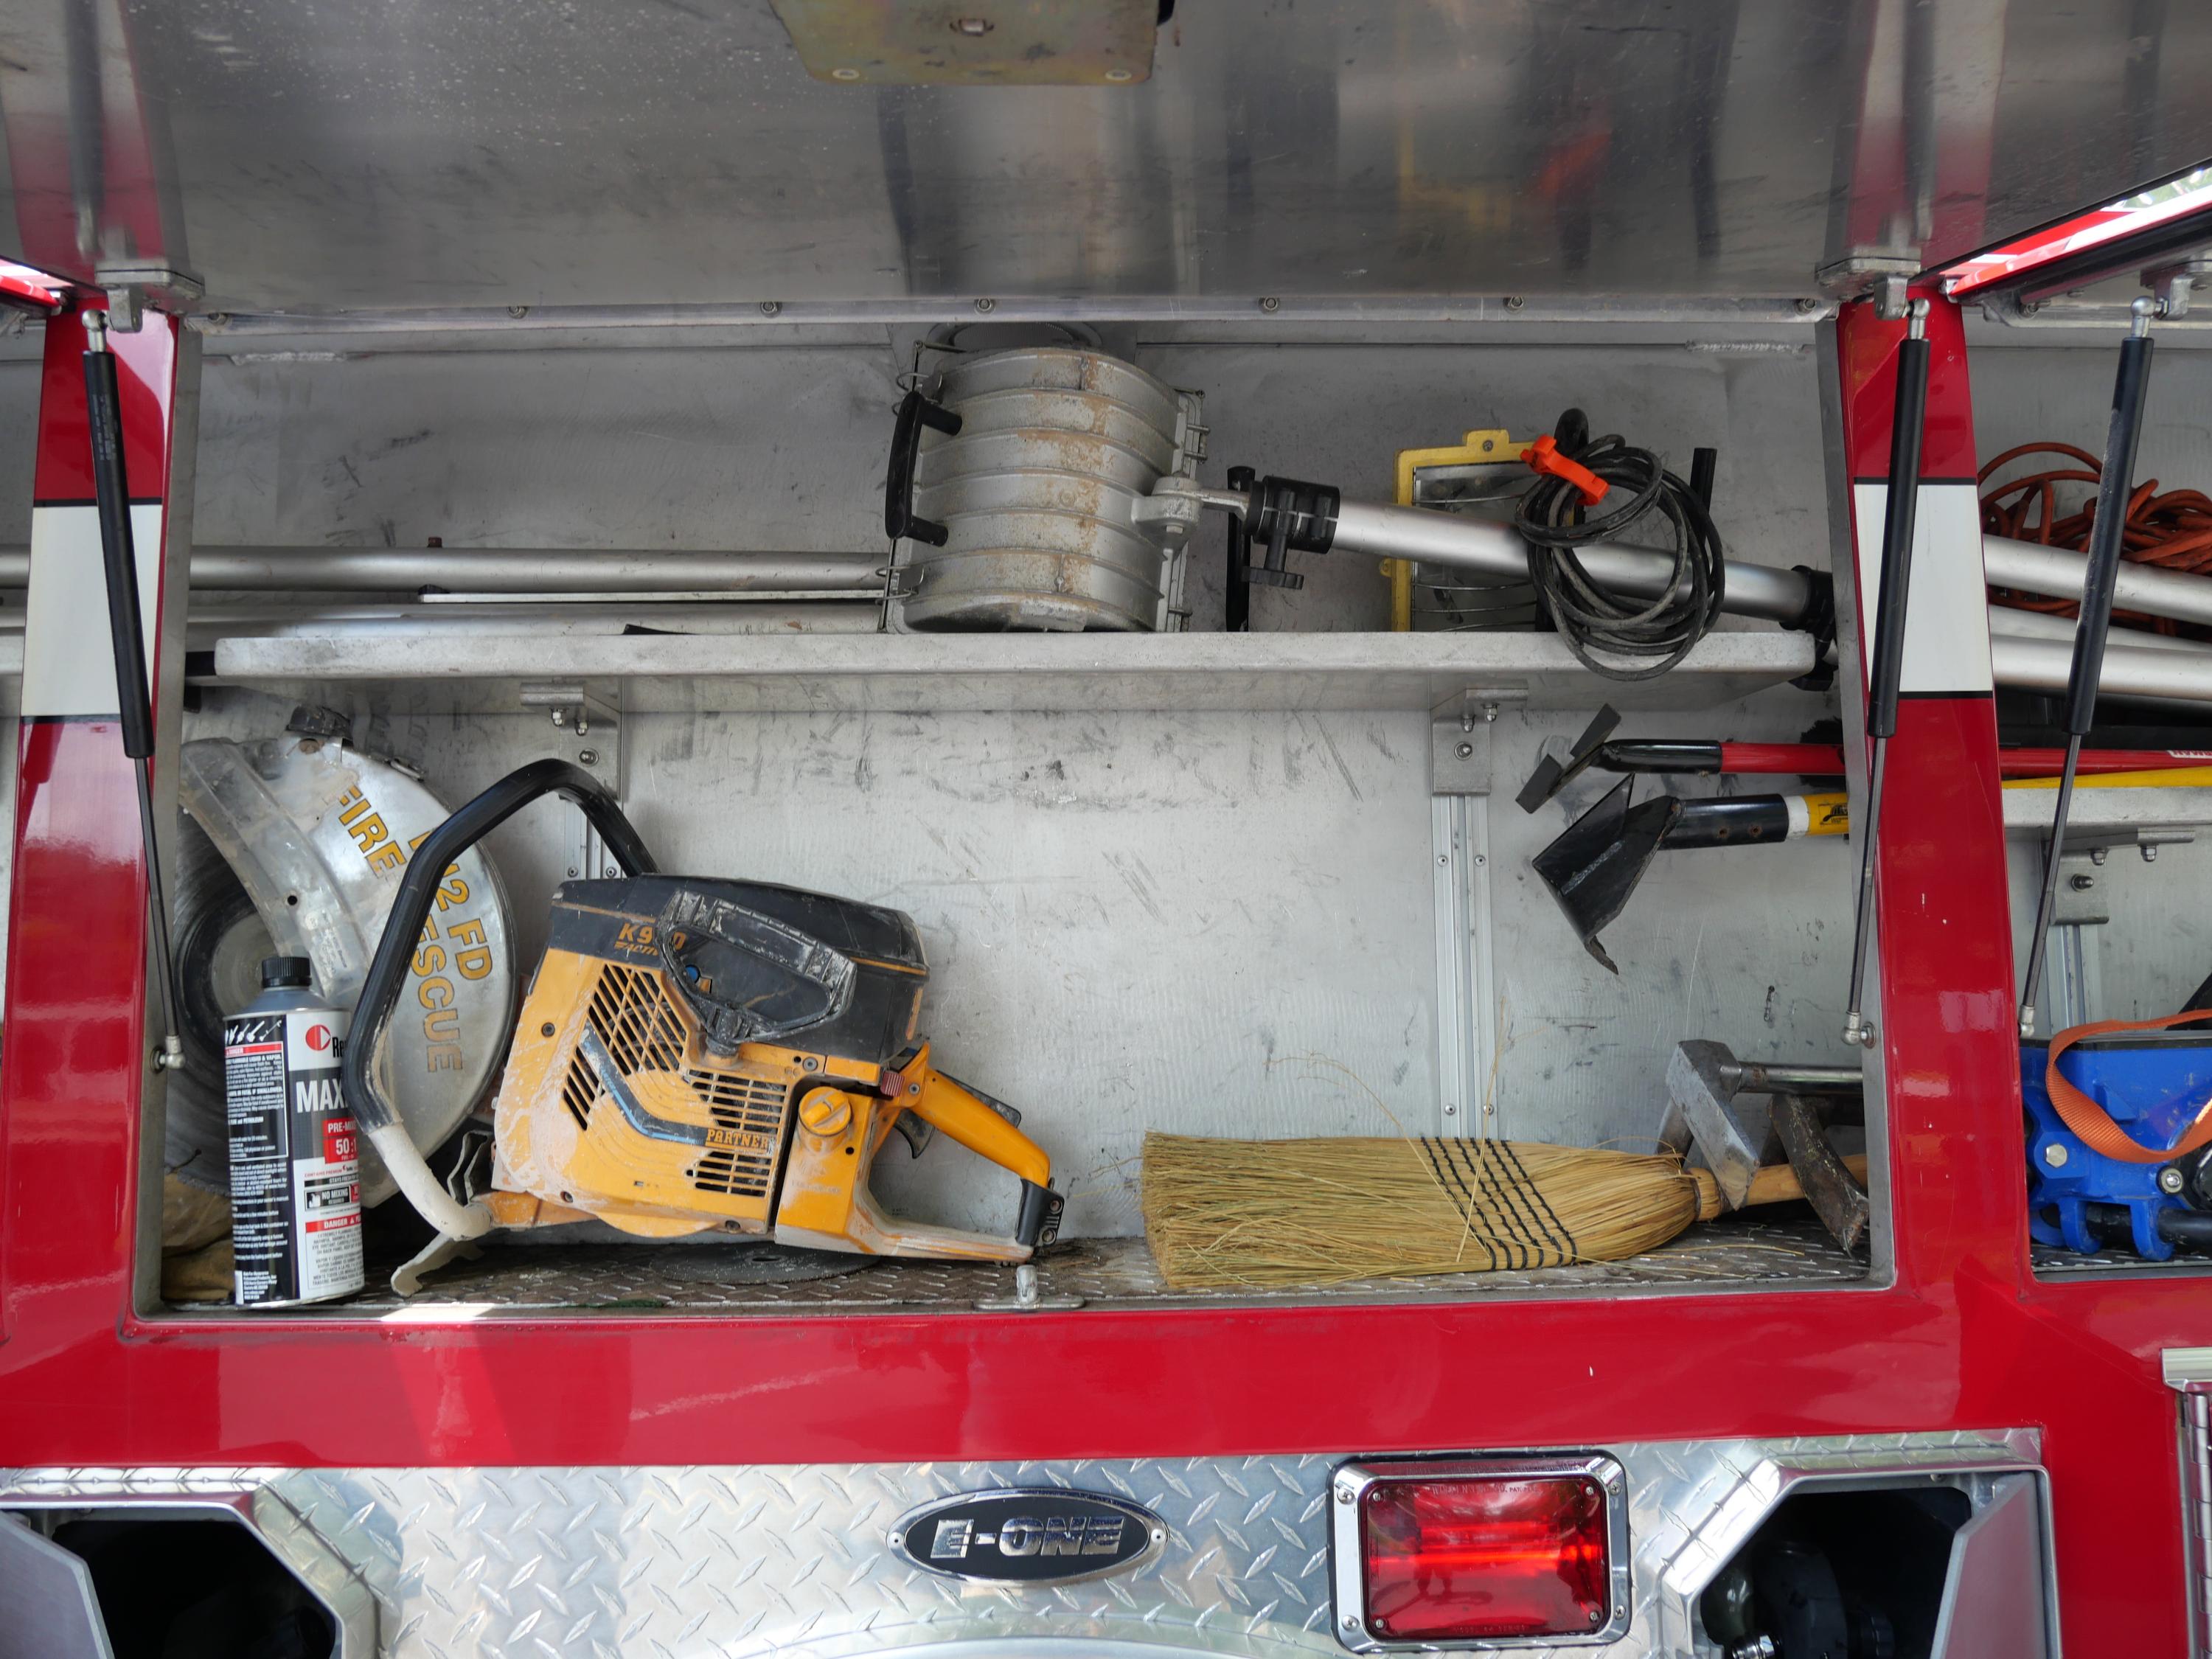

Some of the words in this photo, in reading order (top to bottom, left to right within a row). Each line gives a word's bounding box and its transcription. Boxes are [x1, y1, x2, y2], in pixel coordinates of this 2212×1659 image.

[447, 918, 493, 981] FD
[618, 922, 686, 951] K90
[707, 1127, 769, 1150] PARTNER
[321, 1191, 330, 1200] NO
[330, 1188, 349, 1199] MIXING
[324, 1217, 348, 1229] DANGER
[931, 1516, 1124, 1559] E-ONE
